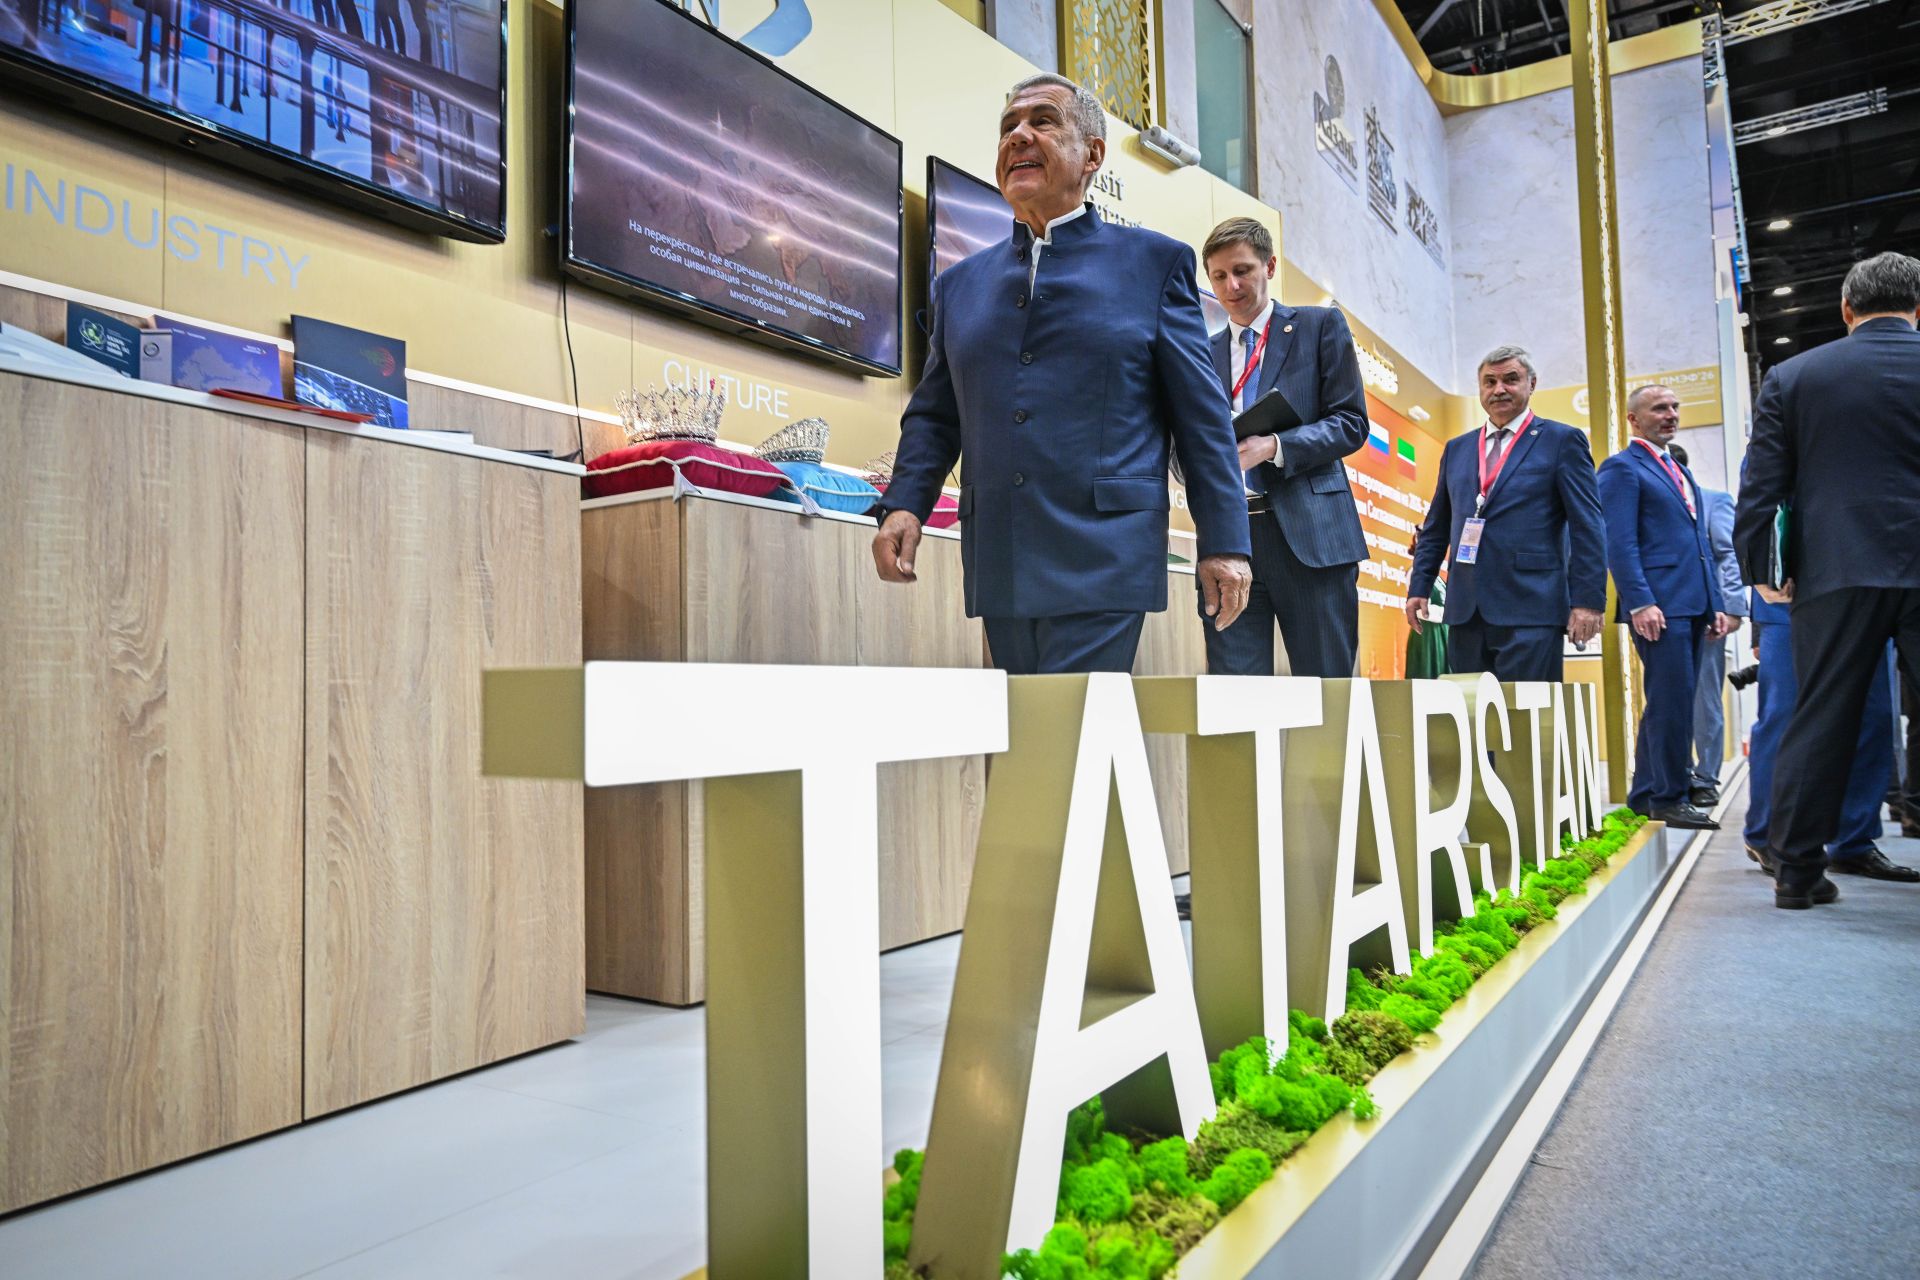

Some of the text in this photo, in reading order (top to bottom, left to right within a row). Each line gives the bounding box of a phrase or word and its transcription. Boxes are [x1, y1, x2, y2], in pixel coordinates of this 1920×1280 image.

[1093, 170, 1124, 201] isit
[6, 162, 311, 289] INDUSTRY
[629, 219, 642, 234] На
[708, 252, 722, 265] где
[724, 259, 773, 284] встречались
[774, 279, 792, 292] пути
[792, 286, 798, 294] и
[650, 244, 682, 264] особая
[684, 257, 740, 285] цивилизация
[751, 284, 783, 302] сильная
[785, 299, 807, 311] своим
[809, 305, 846, 325] единством
[846, 319, 852, 327] в
[663, 360, 790, 419] CULTURE
[584, 660, 1602, 1280] TATARSTAN
